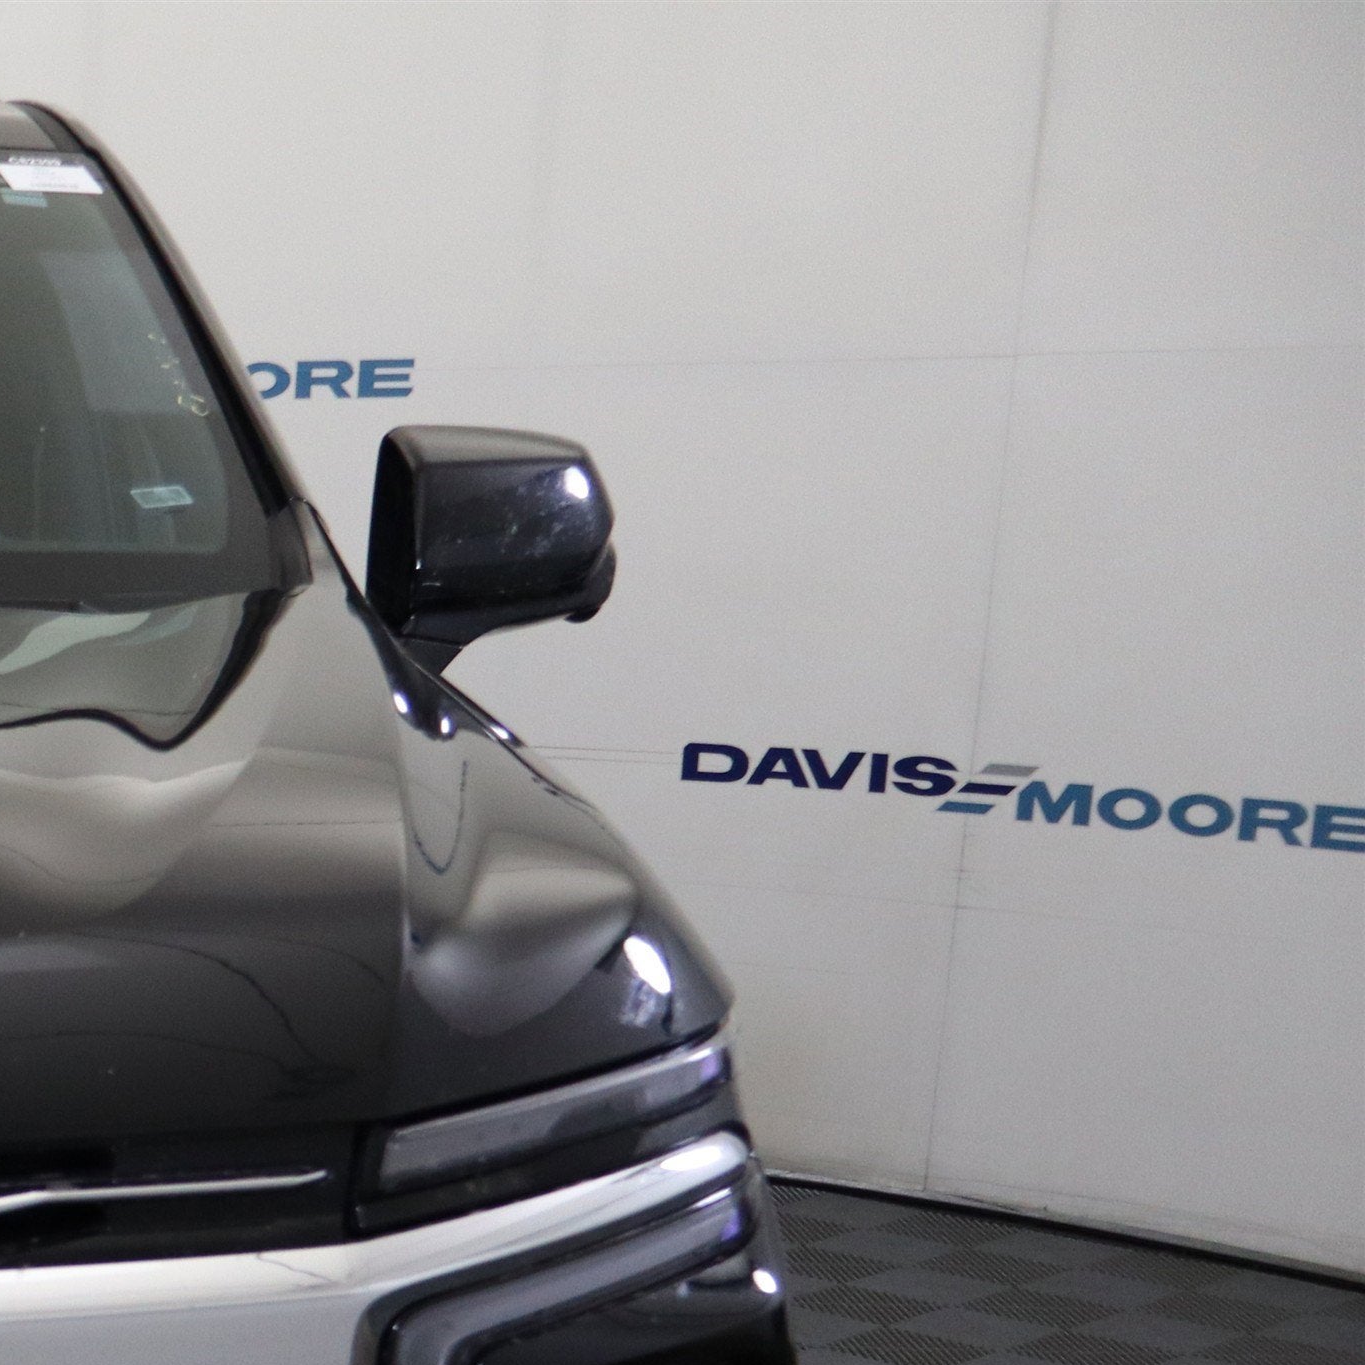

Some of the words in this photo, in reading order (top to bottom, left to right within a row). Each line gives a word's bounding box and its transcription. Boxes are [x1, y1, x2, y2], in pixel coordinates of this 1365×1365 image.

[245, 358, 415, 400] ORE
[680, 742, 959, 797] DAVIS
[1015, 781, 1365, 853] MOORE
